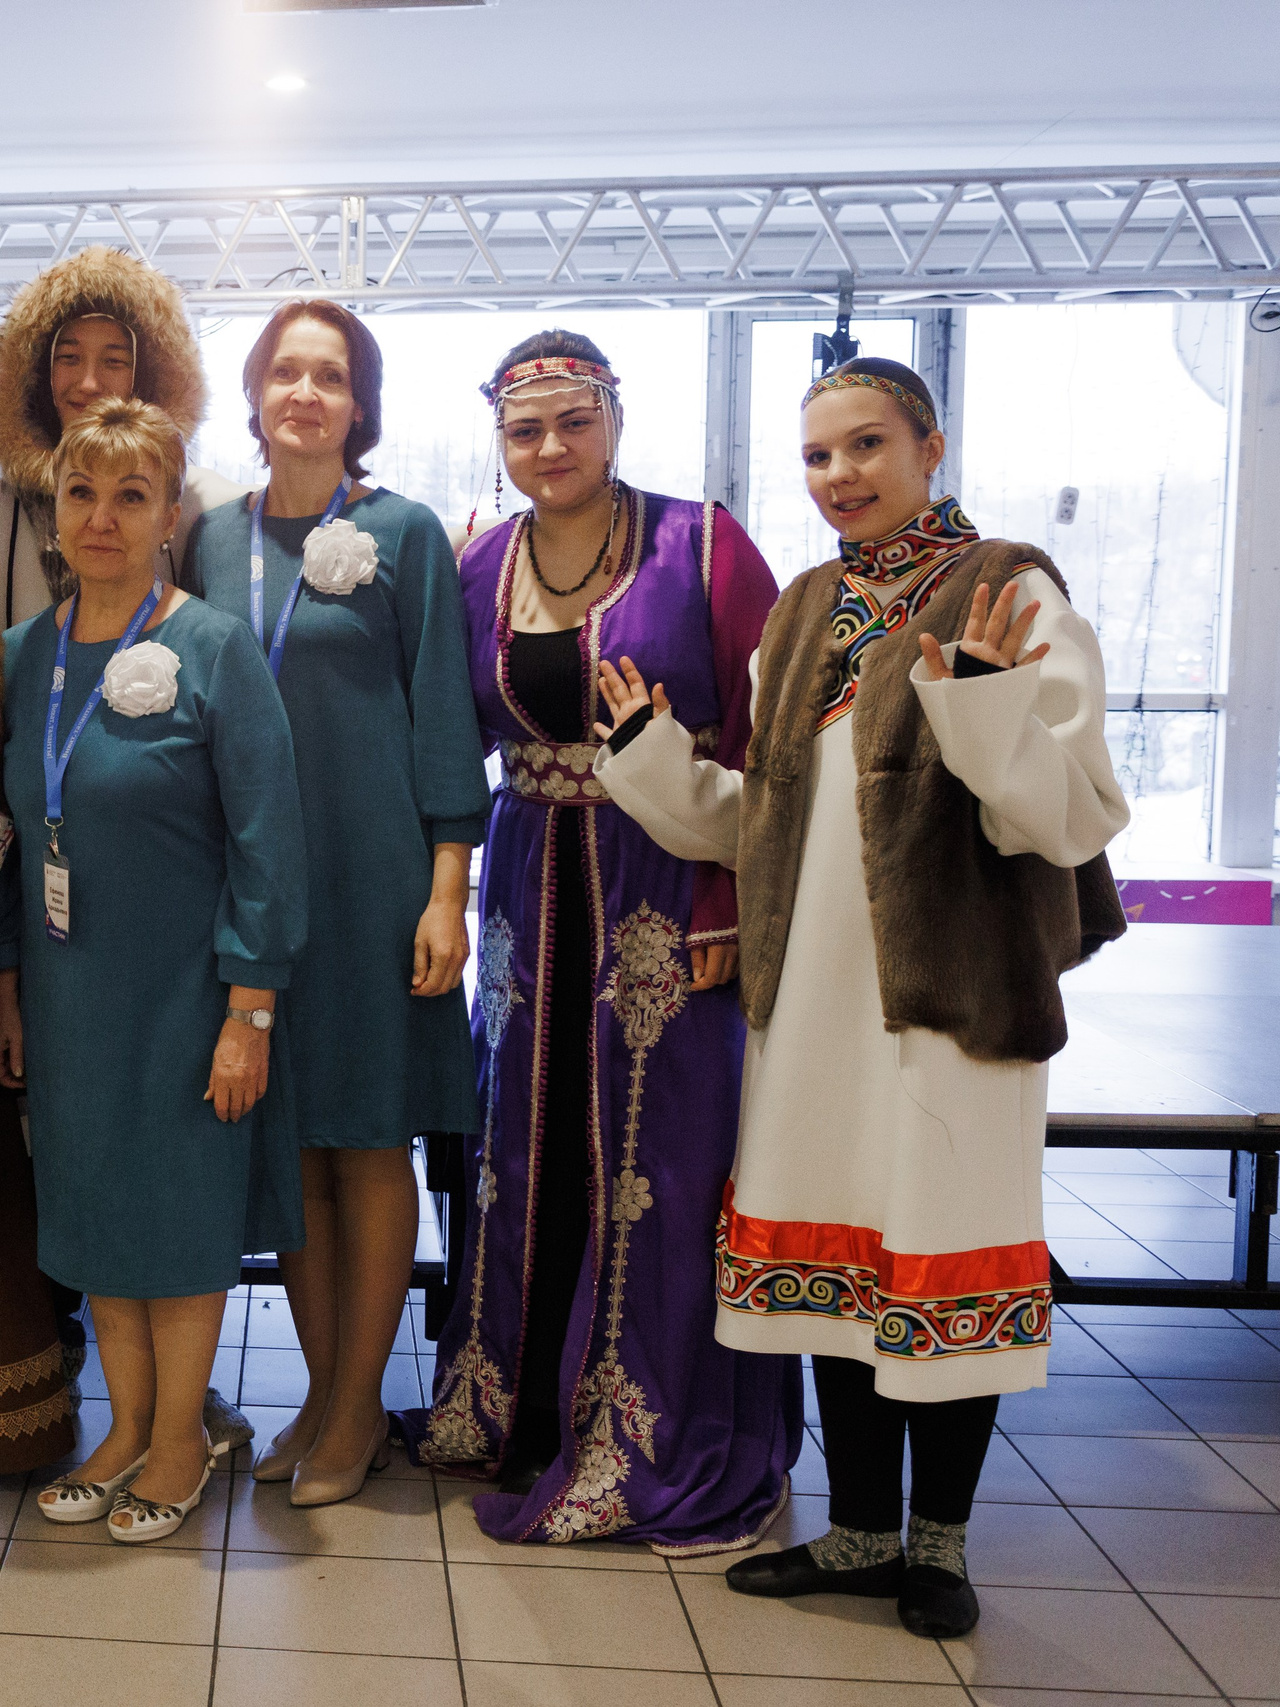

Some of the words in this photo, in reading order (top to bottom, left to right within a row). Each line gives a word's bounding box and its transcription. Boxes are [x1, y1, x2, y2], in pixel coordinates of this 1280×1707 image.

[131, 603, 151, 634] таланты!
[275, 619, 285, 647] Виват,
[50, 703, 59, 724] Виват,
[46, 725, 54, 758] таланты!
[62, 731, 78, 758] Виват,
[74, 702, 93, 732] таланты!
